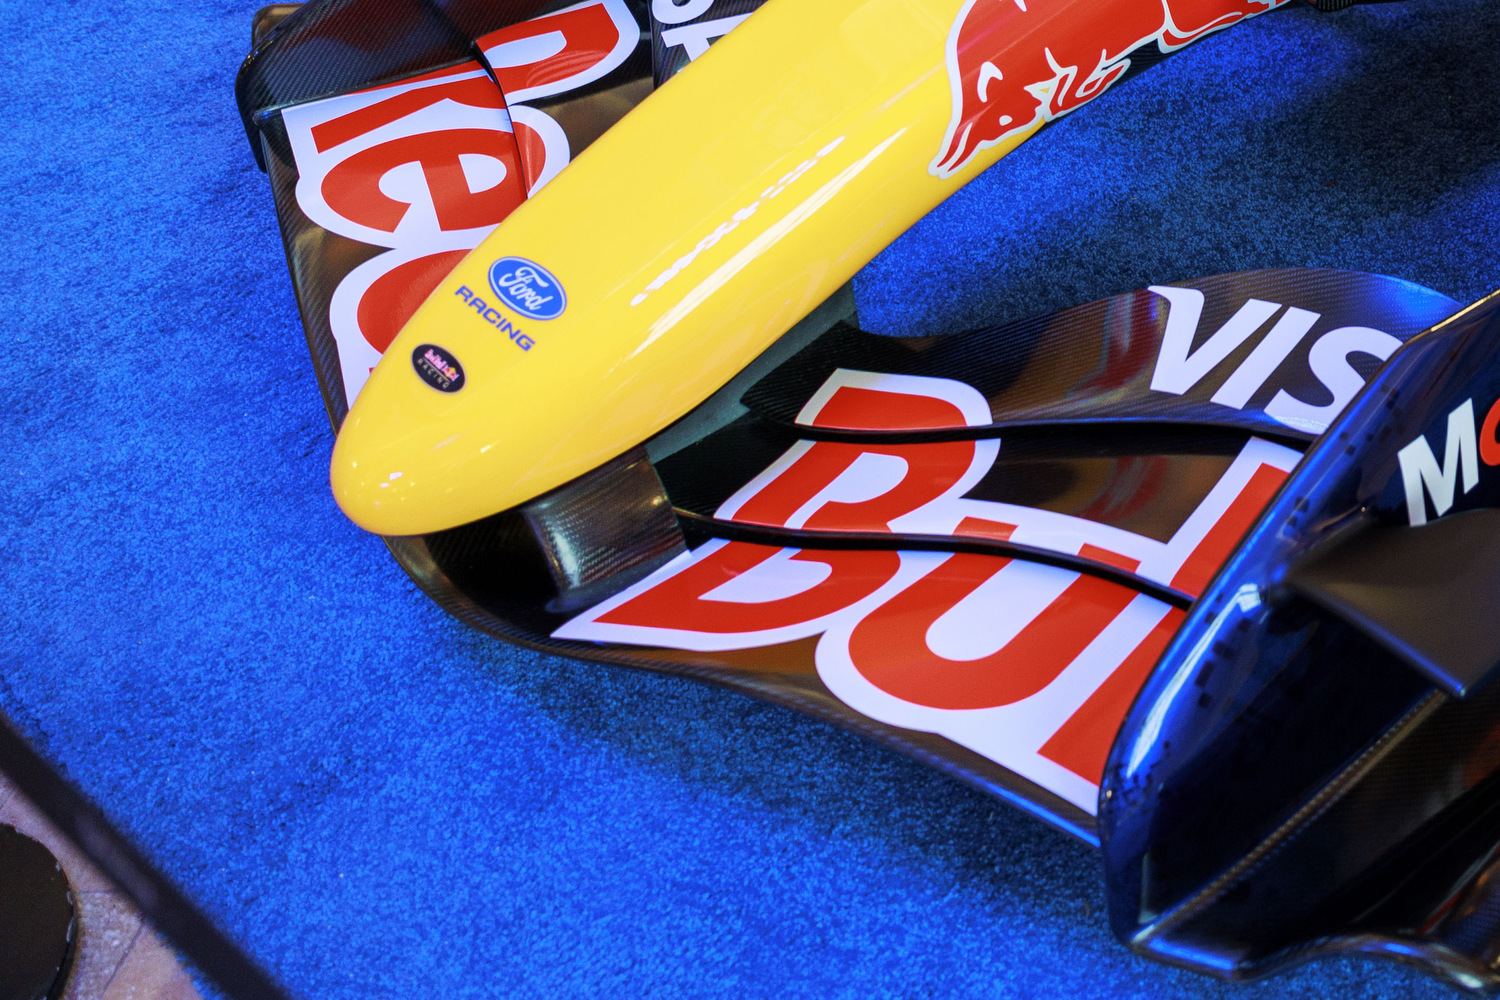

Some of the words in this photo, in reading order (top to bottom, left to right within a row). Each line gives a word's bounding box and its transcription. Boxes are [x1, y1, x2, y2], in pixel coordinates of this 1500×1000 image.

[454, 284, 536, 352] RACING
[498, 266, 554, 312] Ford
[1146, 285, 1405, 434] VIS
